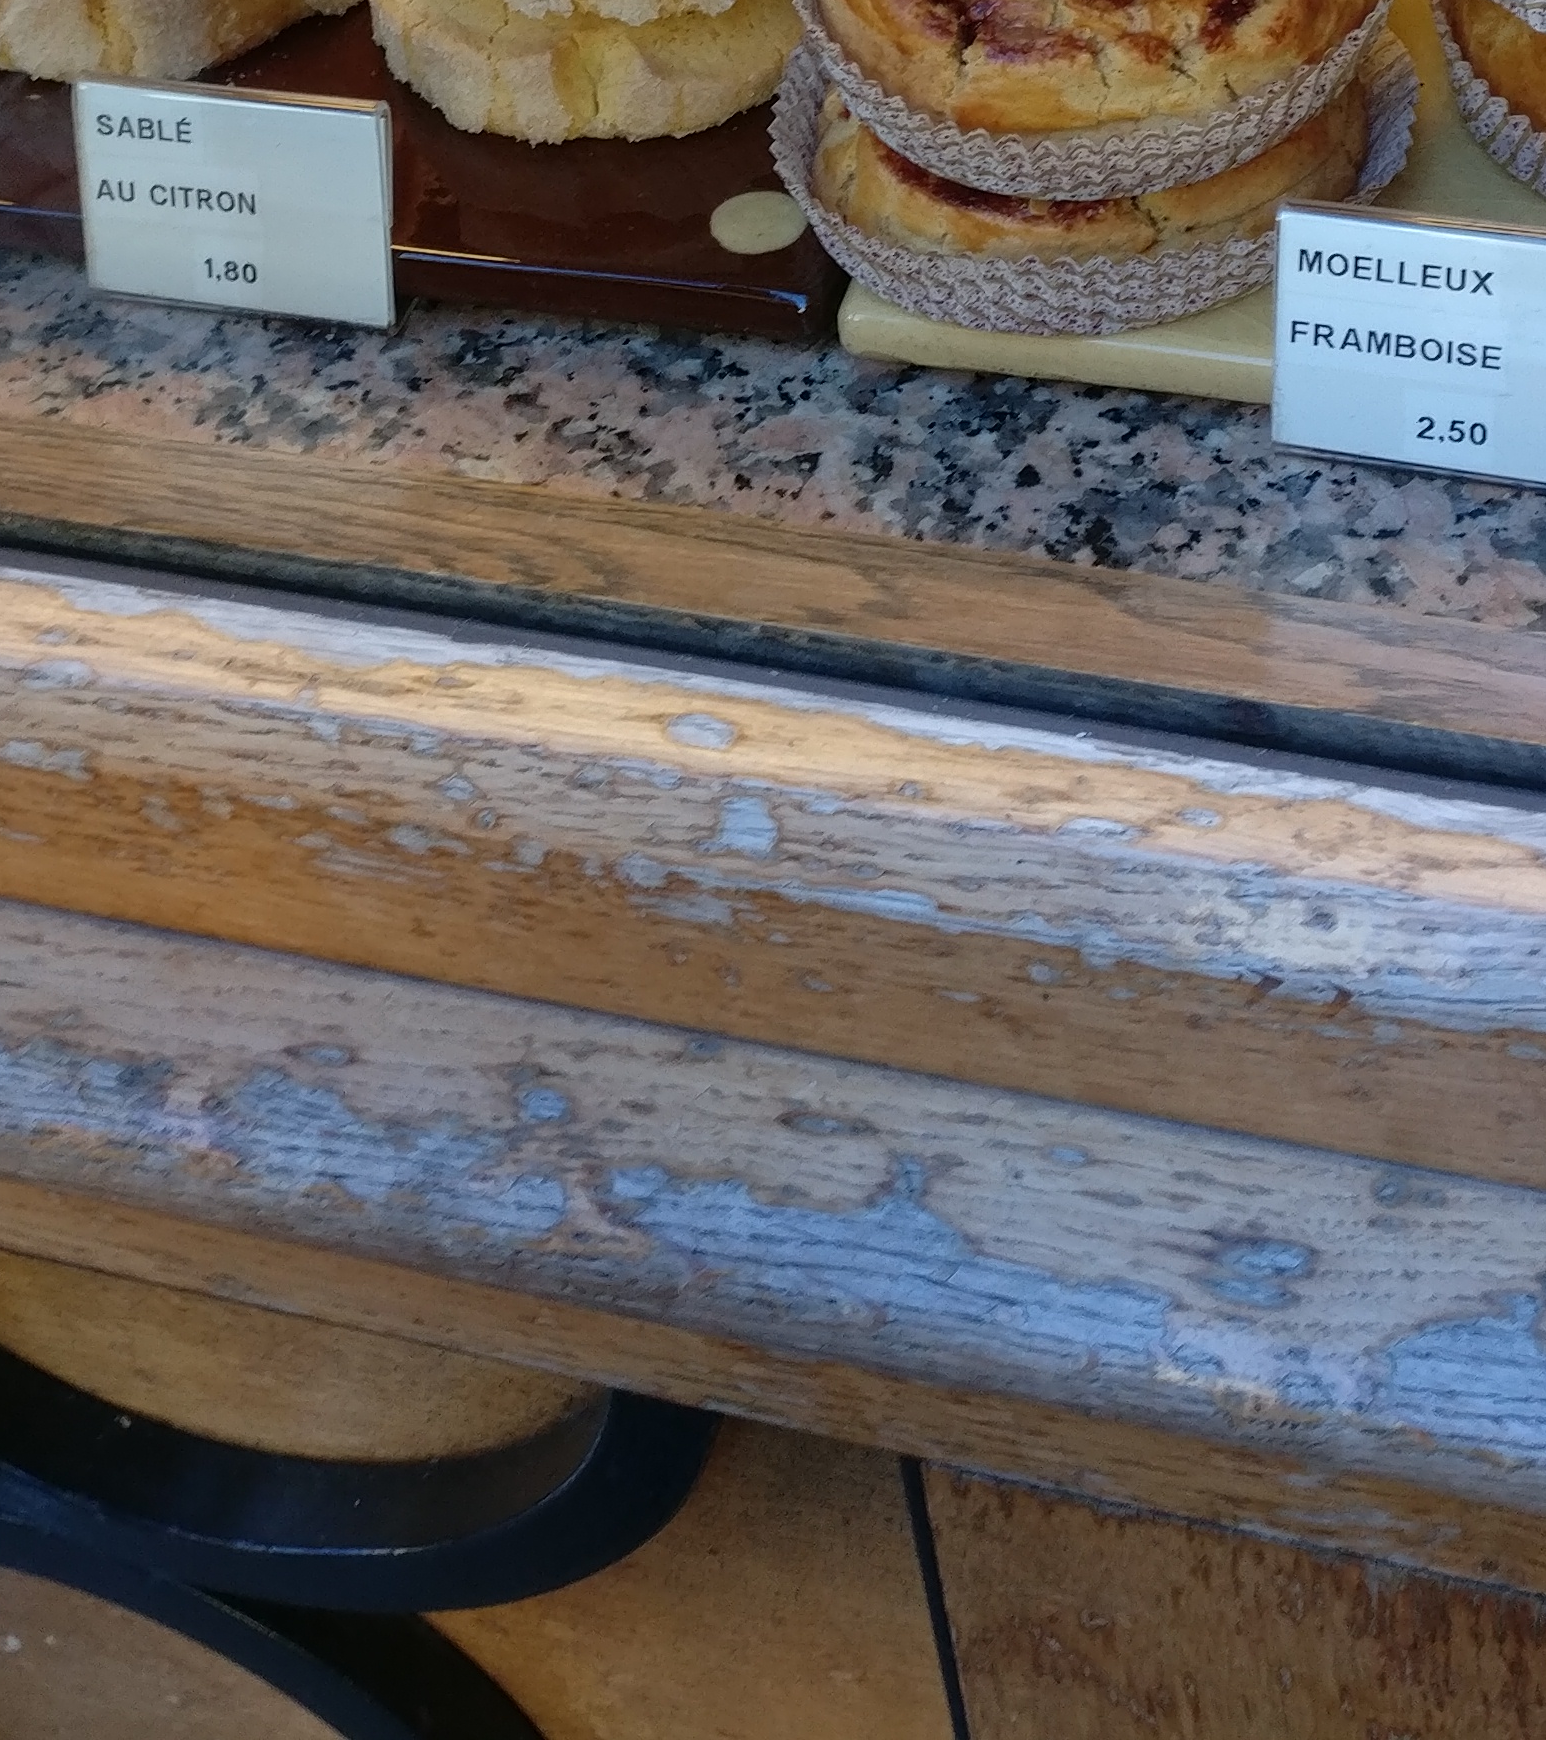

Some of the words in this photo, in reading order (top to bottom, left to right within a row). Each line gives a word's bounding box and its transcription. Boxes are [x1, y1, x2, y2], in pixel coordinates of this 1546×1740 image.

[96, 113, 193, 144] SABLÉ
[96, 178, 136, 203] AU
[149, 183, 257, 216] CITRON
[1297, 247, 1495, 296] MOELLEUX
[1289, 320, 1503, 371] FRAMBOISE
